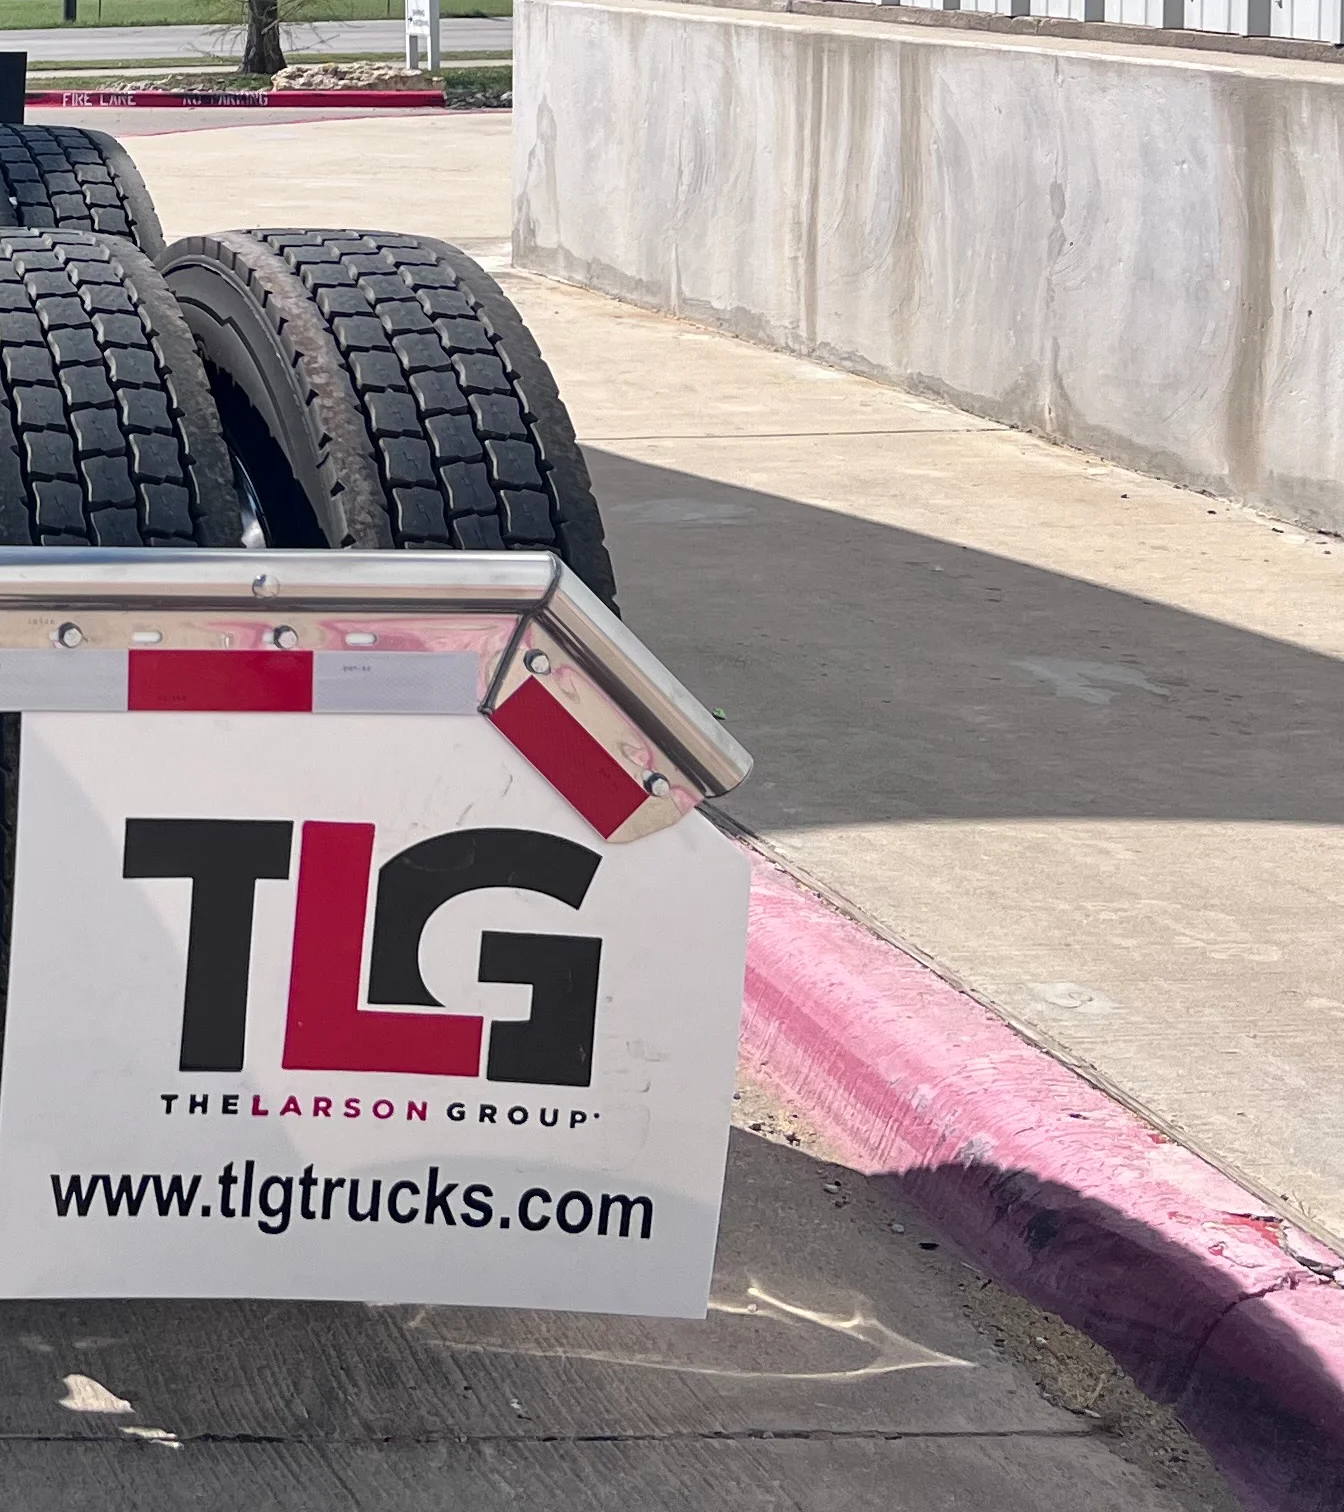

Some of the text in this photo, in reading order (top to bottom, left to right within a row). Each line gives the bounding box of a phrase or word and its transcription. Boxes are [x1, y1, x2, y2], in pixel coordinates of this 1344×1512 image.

[62, 91, 93, 107] FIRE
[99, 91, 137, 106] LANE
[123, 817, 603, 1088] TLG
[50, 1159, 654, 1240] www.tlgtrucks.com
